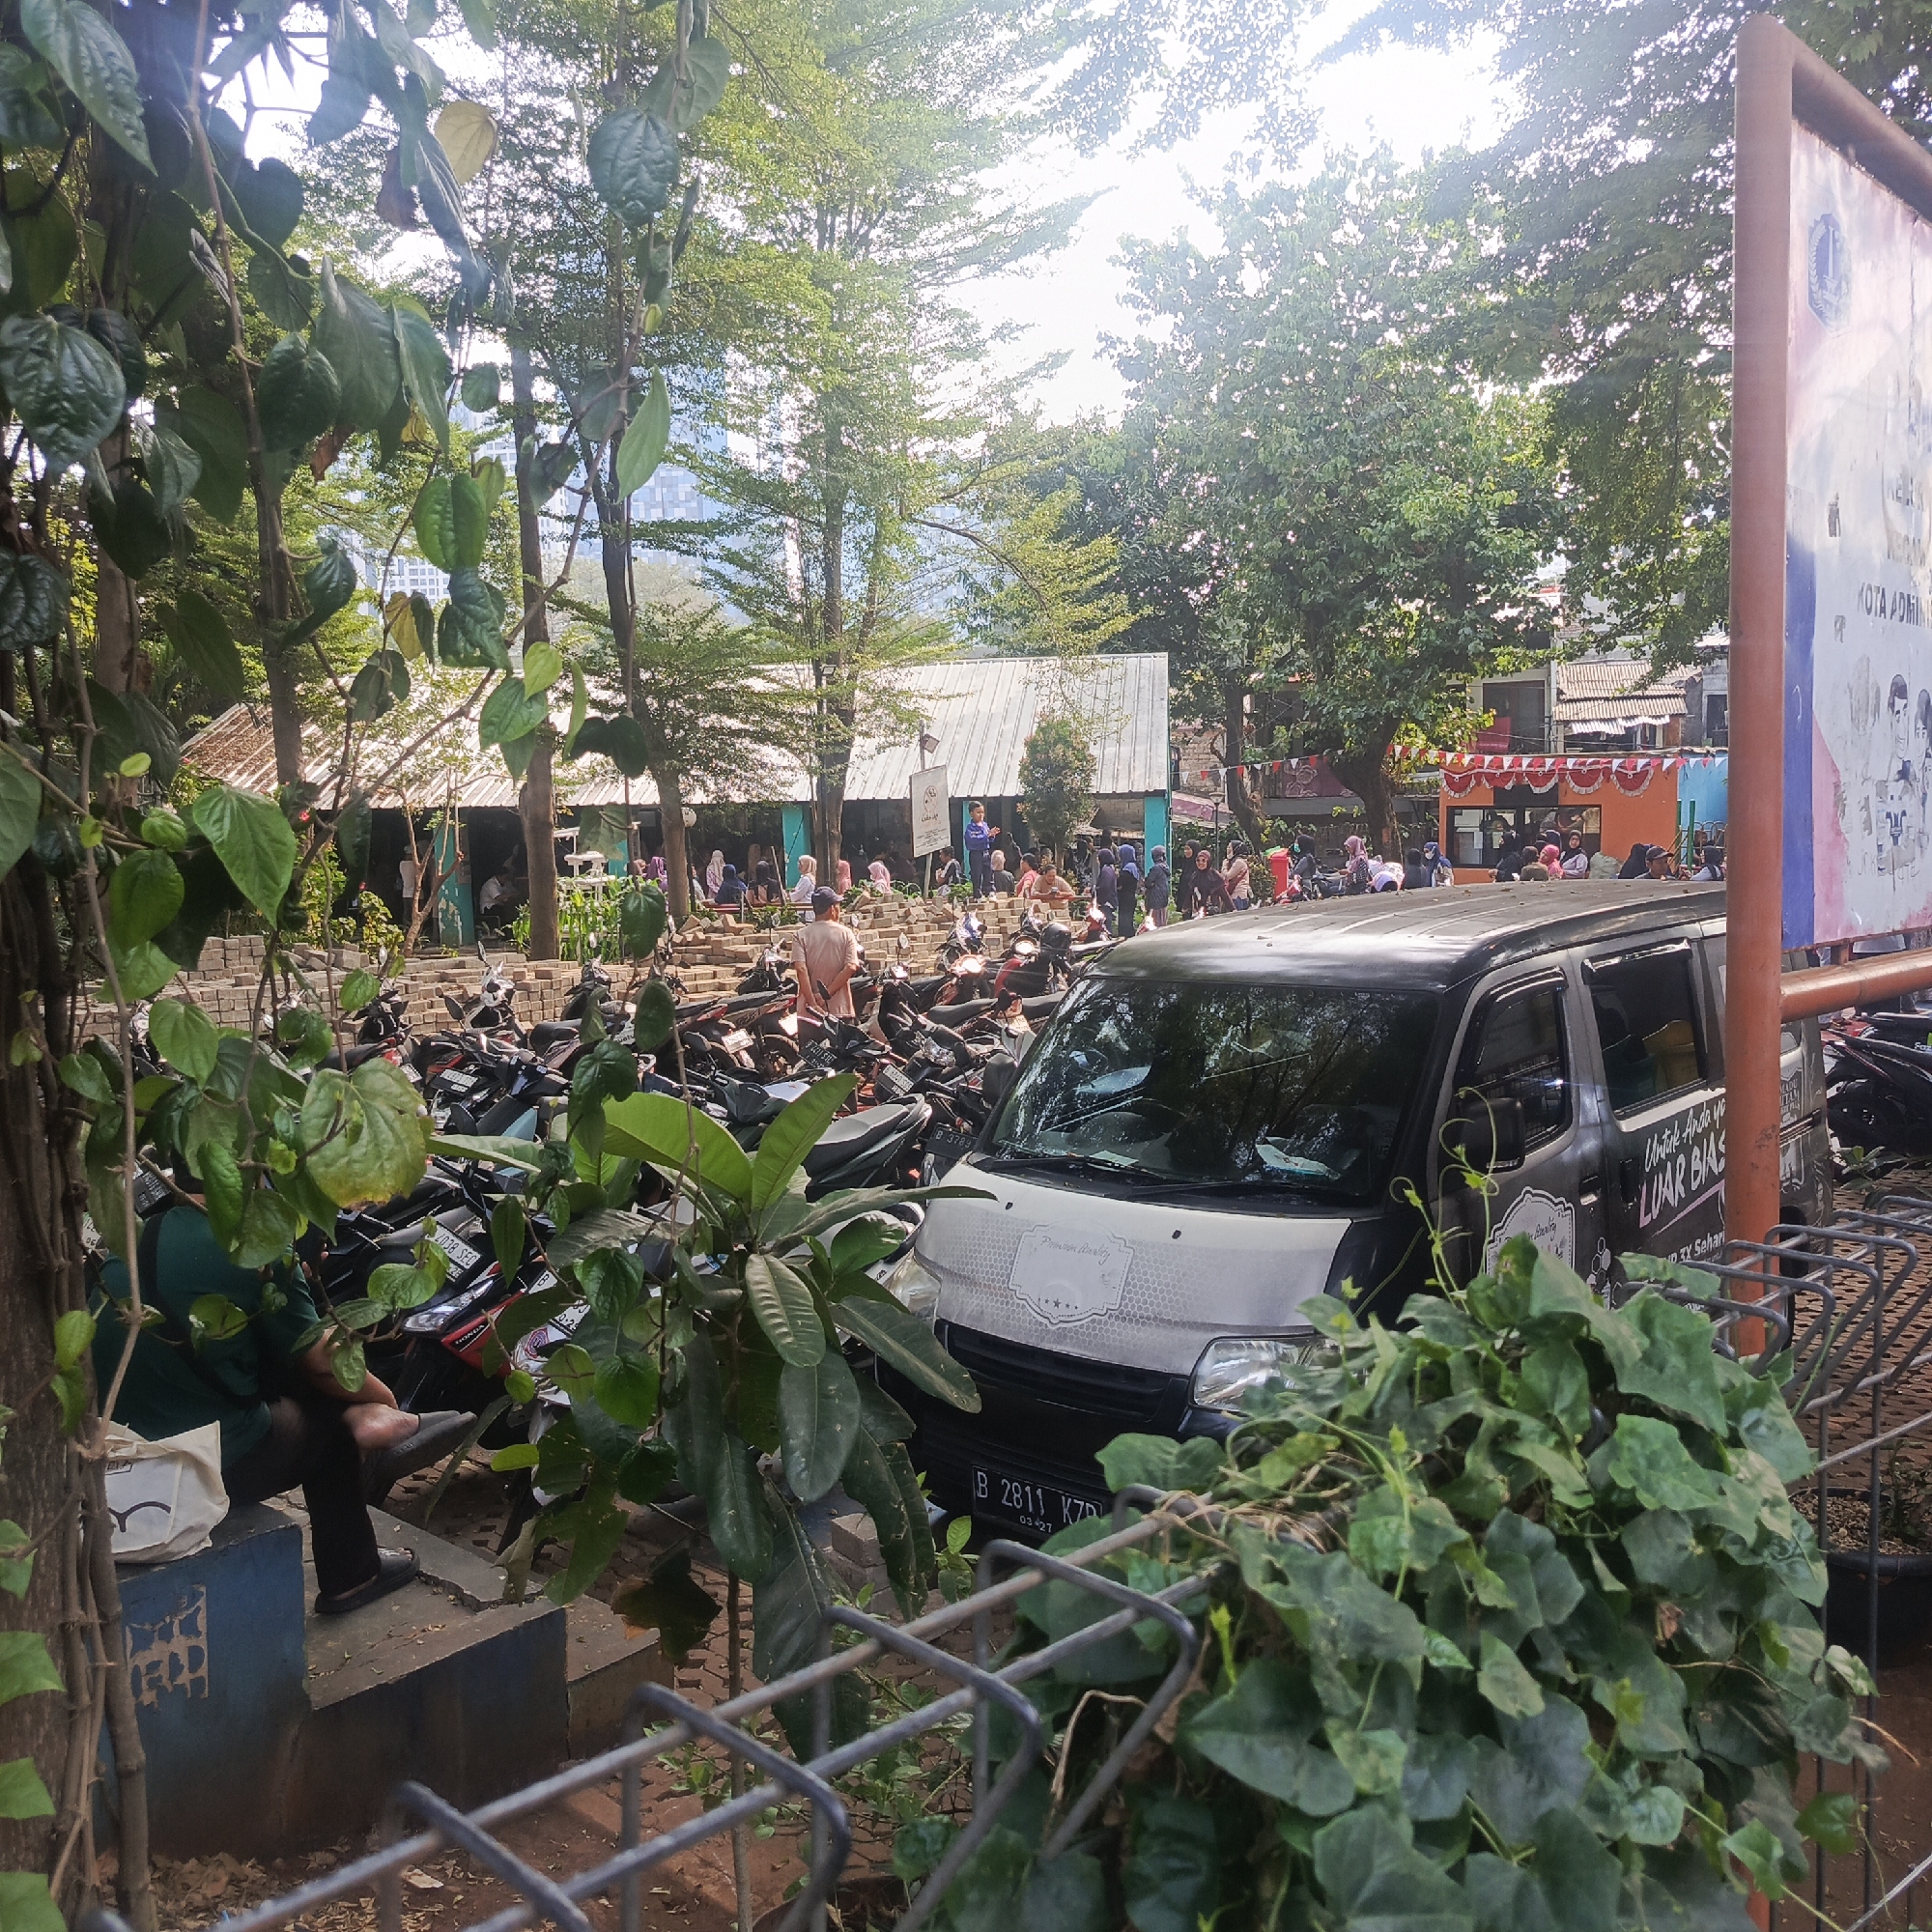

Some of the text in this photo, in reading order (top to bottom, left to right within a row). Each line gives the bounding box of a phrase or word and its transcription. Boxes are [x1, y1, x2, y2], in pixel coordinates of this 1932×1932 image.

[1858, 582, 1887, 619] KOTA
[1645, 1121, 1680, 1173] Untuk
[1682, 1101, 1712, 1146] Anda
[1639, 1153, 1687, 1229] LUAR
[455, 1324, 485, 1345] HONDA
[977, 1470, 988, 1498] B
[1001, 1478, 1045, 1517] 2811
